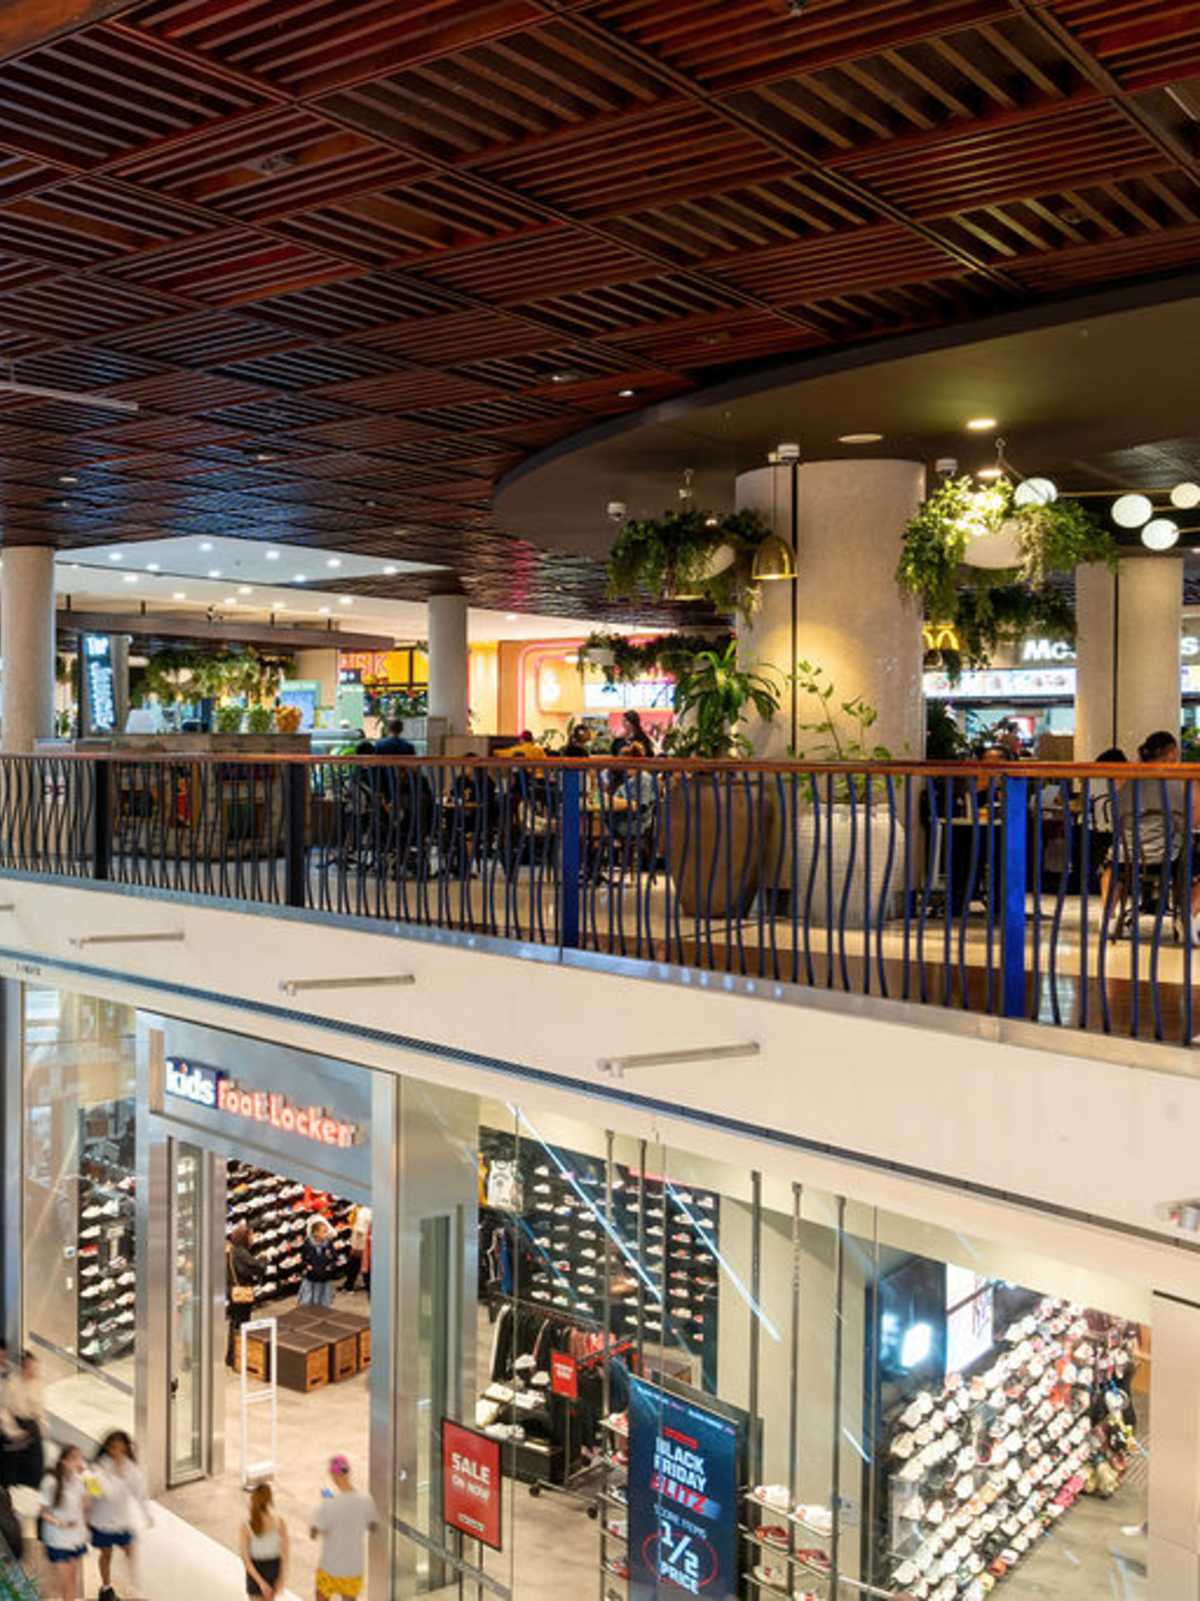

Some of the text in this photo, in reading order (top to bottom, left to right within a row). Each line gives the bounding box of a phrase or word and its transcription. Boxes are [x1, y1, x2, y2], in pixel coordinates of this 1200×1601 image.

[166, 1061, 357, 1147] kids Foot Locker
[451, 1452, 491, 1485] SALE
[653, 1453, 707, 1493] FRIDAY
[655, 1437, 705, 1476] BLACK
[467, 1480, 491, 1502] NOW
[660, 1520, 700, 1579] 1/2
[659, 1560, 700, 1595] PRICE
